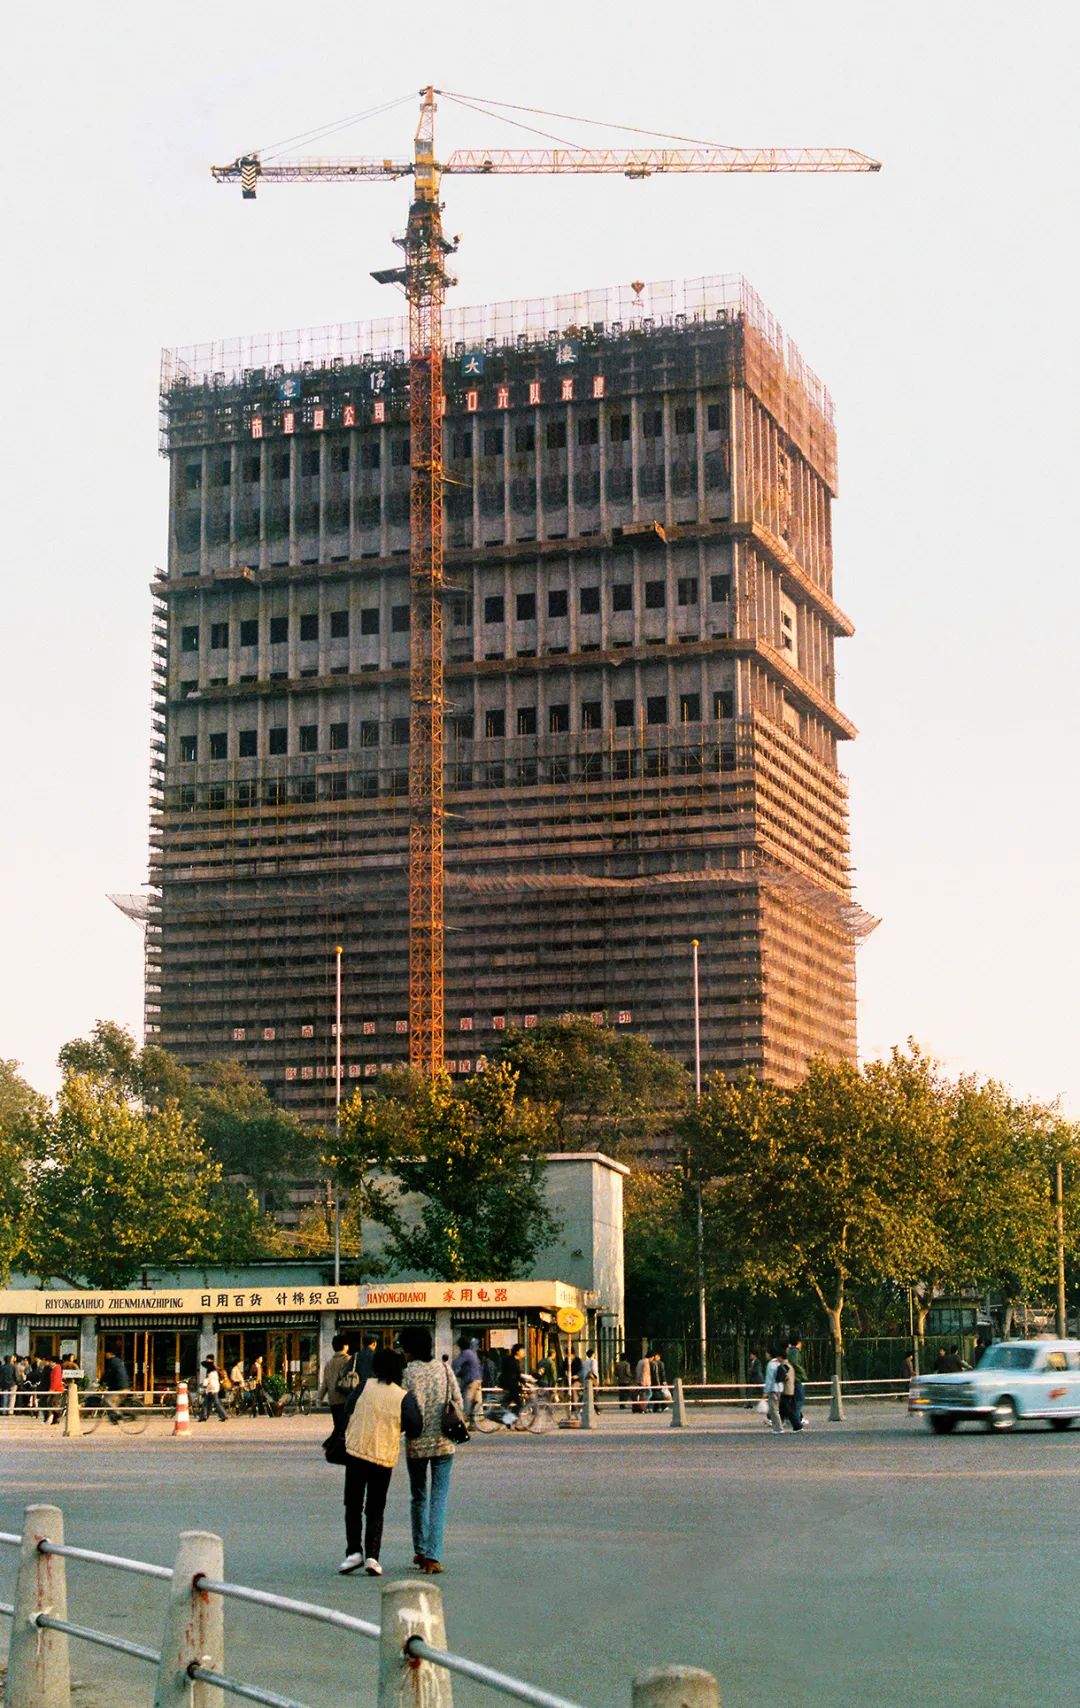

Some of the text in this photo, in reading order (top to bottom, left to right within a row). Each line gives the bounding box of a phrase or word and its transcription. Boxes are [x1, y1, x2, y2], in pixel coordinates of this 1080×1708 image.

[201, 1291, 339, 1307] 日用百货 针棉织品
[443, 1288, 508, 1302] 家用电器
[45, 1297, 184, 1310] RIYONGBAIHUO ZHENMIANZHIPING
